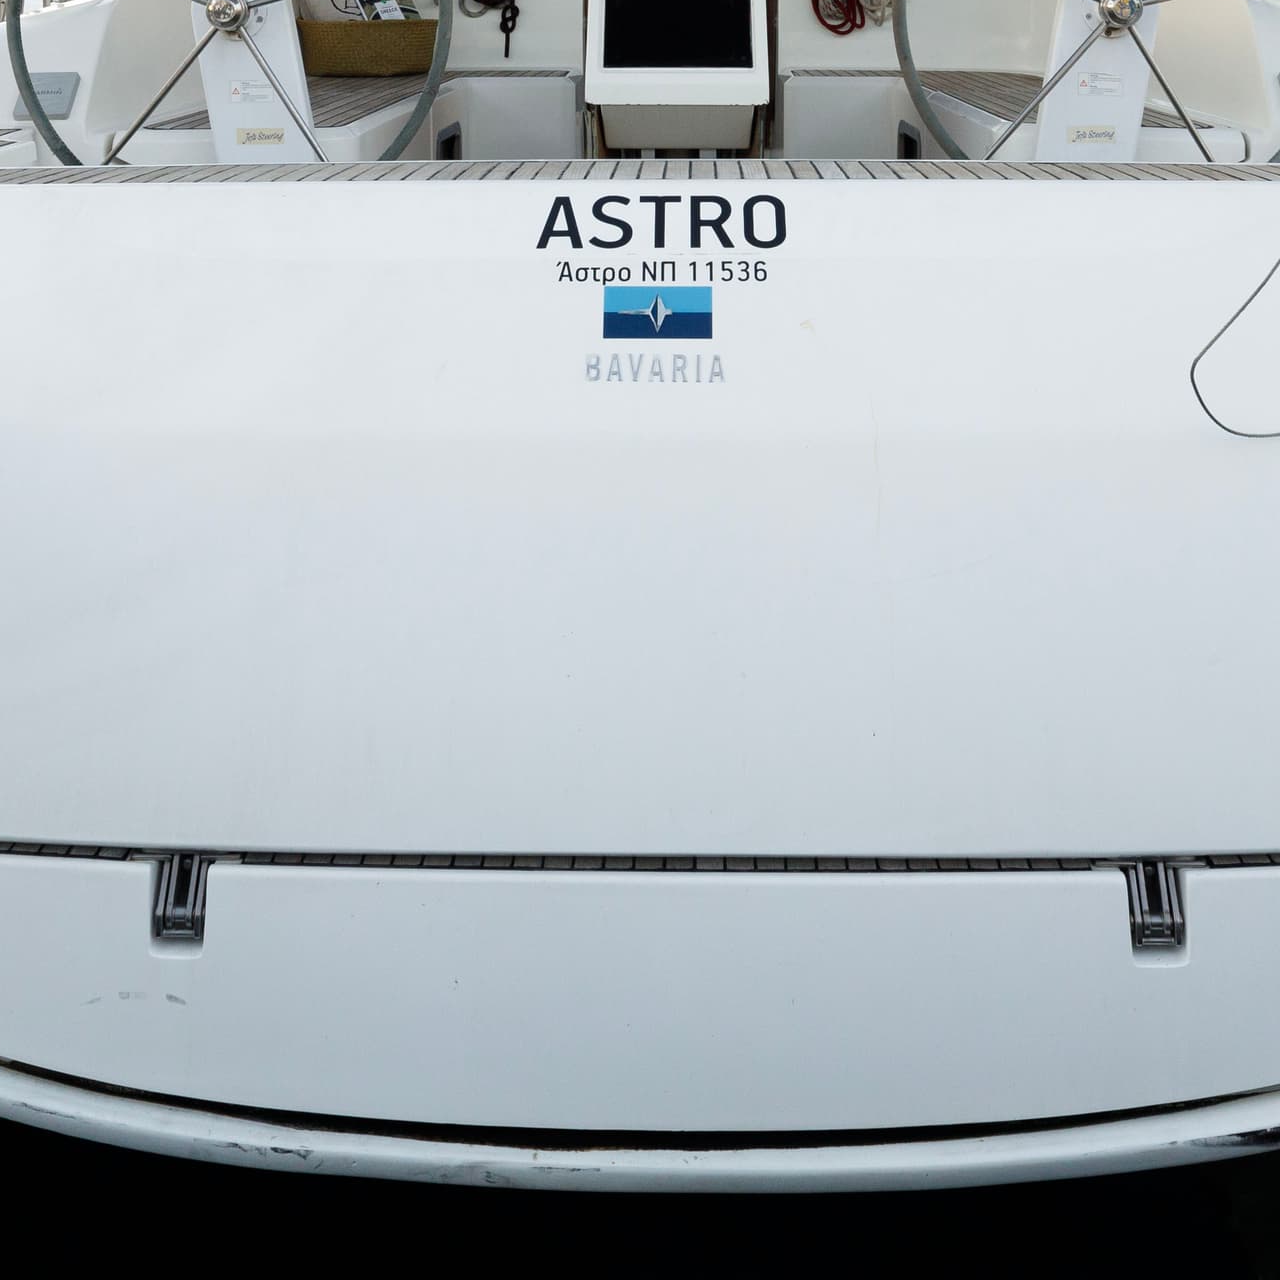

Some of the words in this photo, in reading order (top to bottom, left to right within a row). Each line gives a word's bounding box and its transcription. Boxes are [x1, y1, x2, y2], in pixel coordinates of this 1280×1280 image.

[536, 194, 787, 249] ASTRO
[556, 261, 631, 286] Άστρο
[689, 261, 768, 282] 11536
[585, 353, 725, 383] BAVARIA
